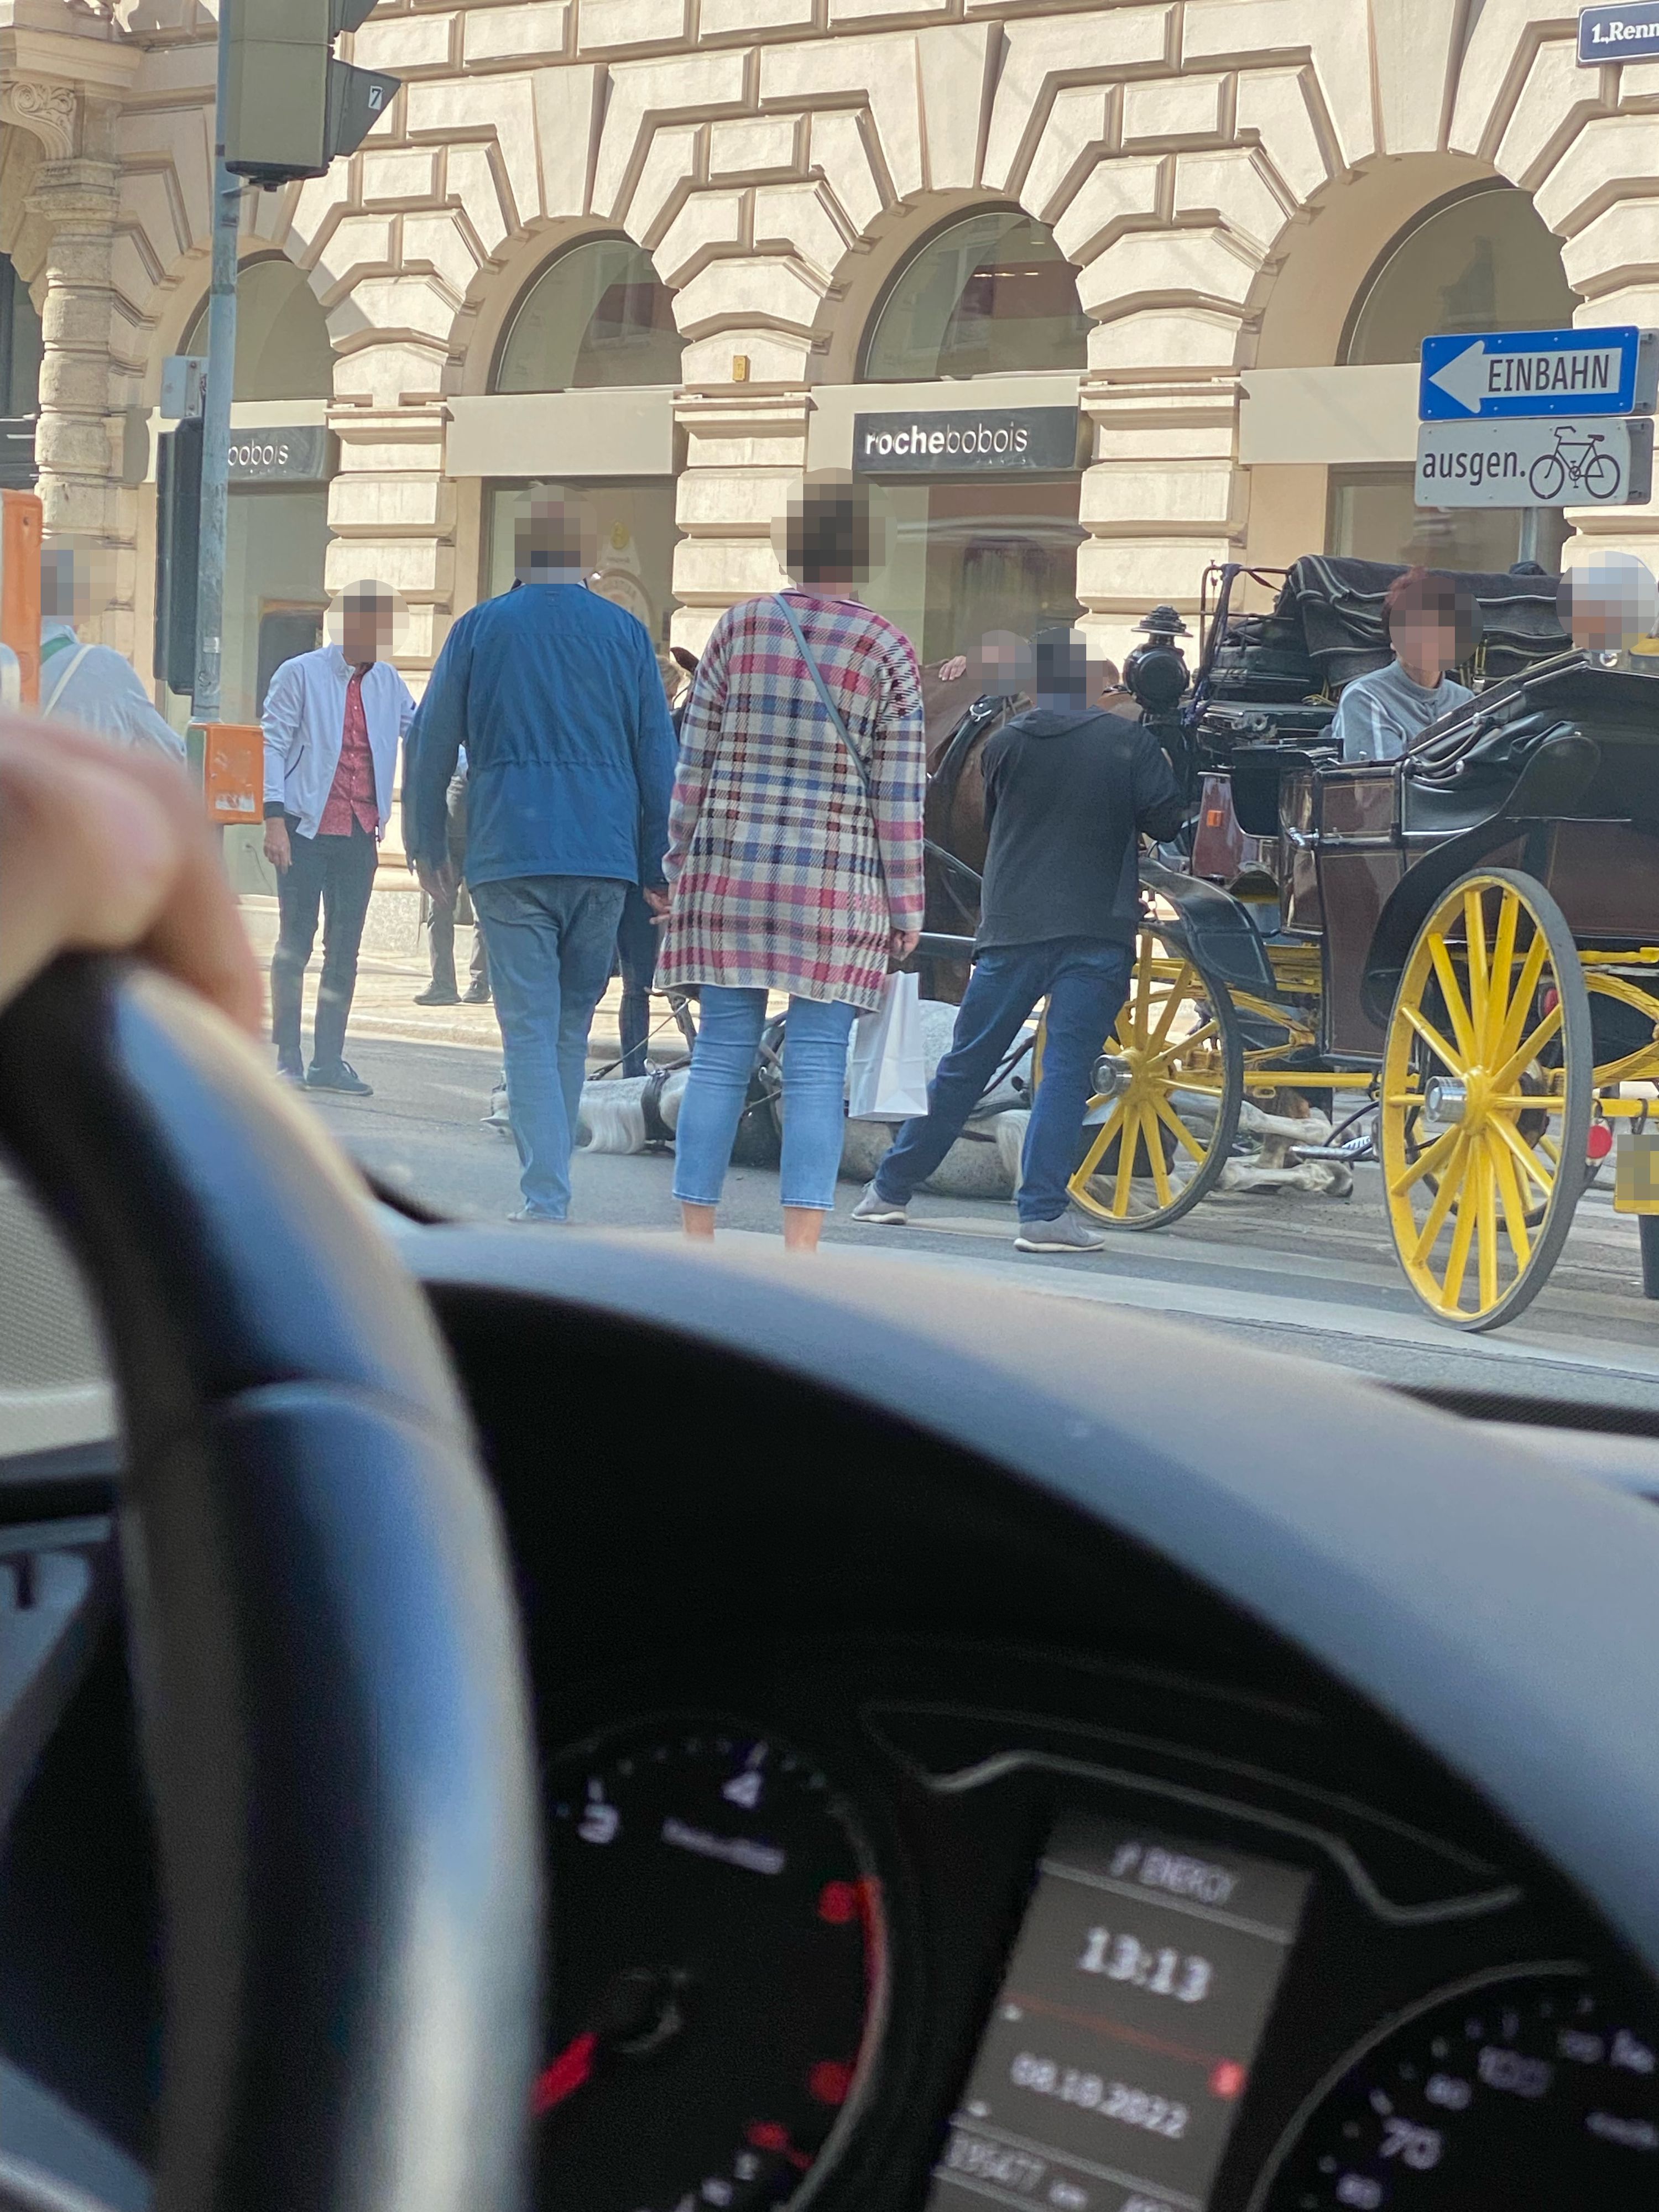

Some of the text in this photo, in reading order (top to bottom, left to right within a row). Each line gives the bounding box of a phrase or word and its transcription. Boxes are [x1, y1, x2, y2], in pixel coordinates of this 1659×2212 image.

[371, 88, 381, 107] 7
[1488, 354, 1609, 392] EINBAHN
[1423, 451, 1526, 486] ausgen.
[1077, 1927, 1212, 2002] 13:13
[1381, 2116, 1441, 2169] 70
